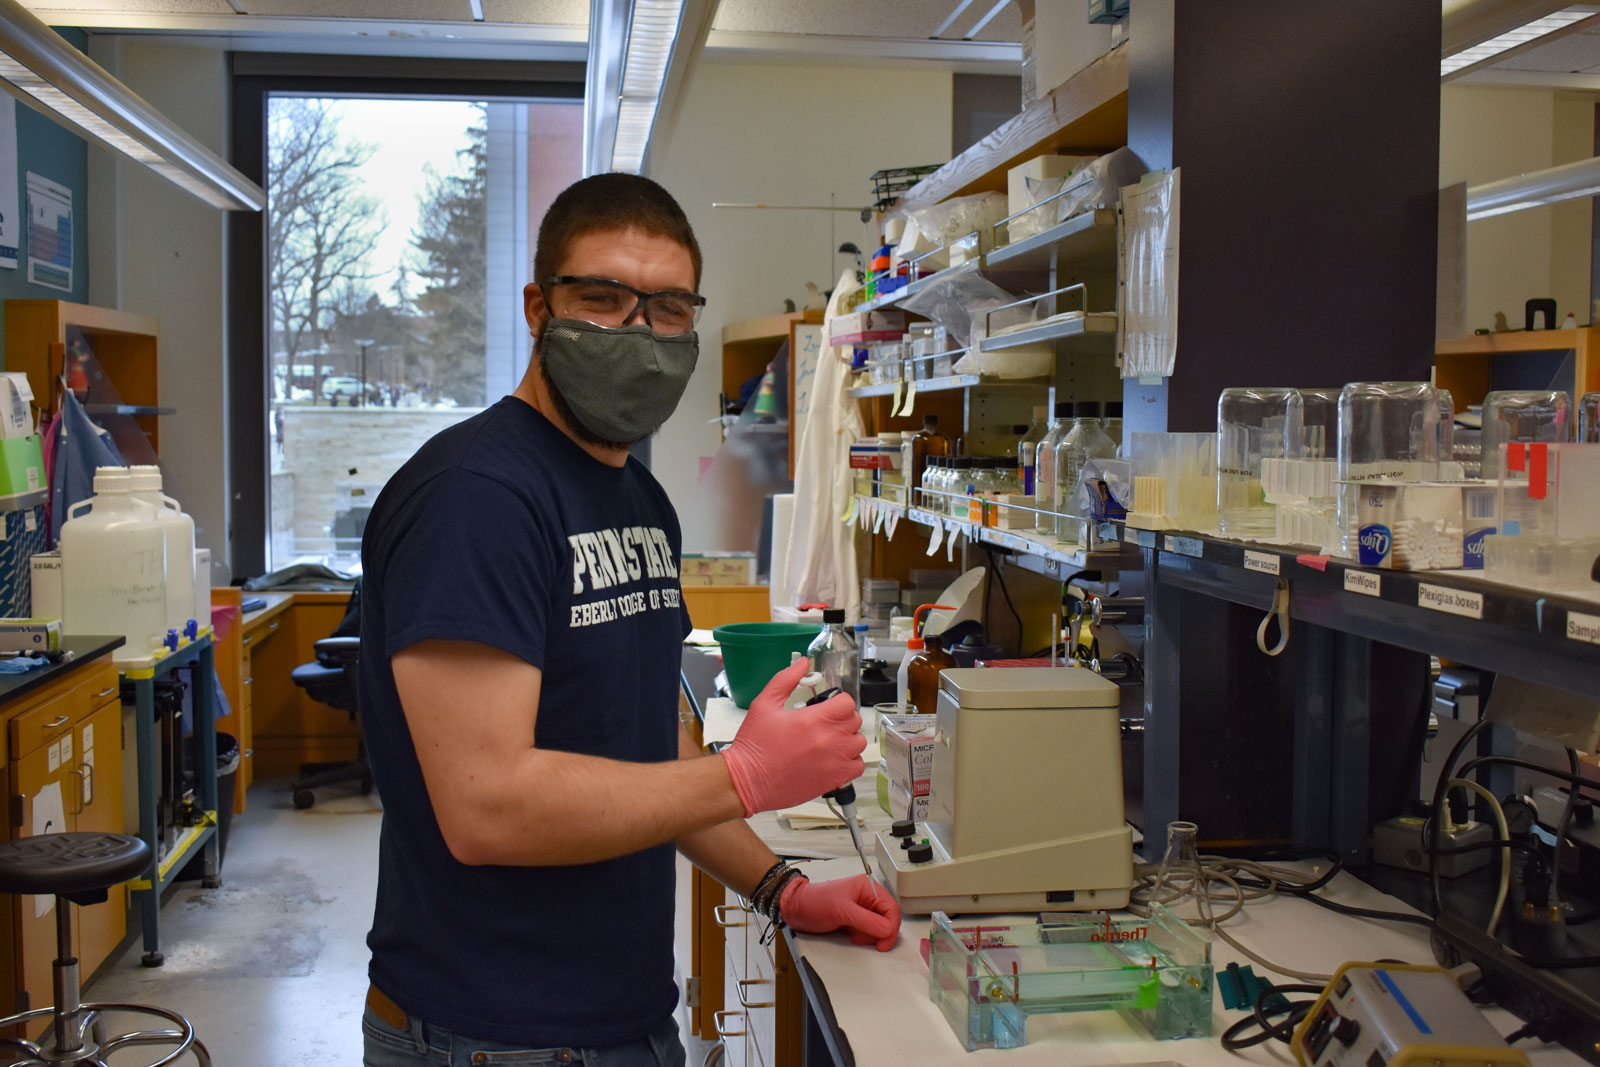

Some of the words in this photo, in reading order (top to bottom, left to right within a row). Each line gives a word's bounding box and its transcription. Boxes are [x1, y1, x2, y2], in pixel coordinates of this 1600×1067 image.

[1368, 495, 1384, 507] 750
[1244, 555, 1260, 569] Power
[1260, 559, 1278, 572] source
[1344, 573, 1377, 590] KimWipes
[1419, 586, 1453, 608] Plexiglas
[1454, 593, 1480, 611] boxes
[569, 598, 618, 628] EBERLY
